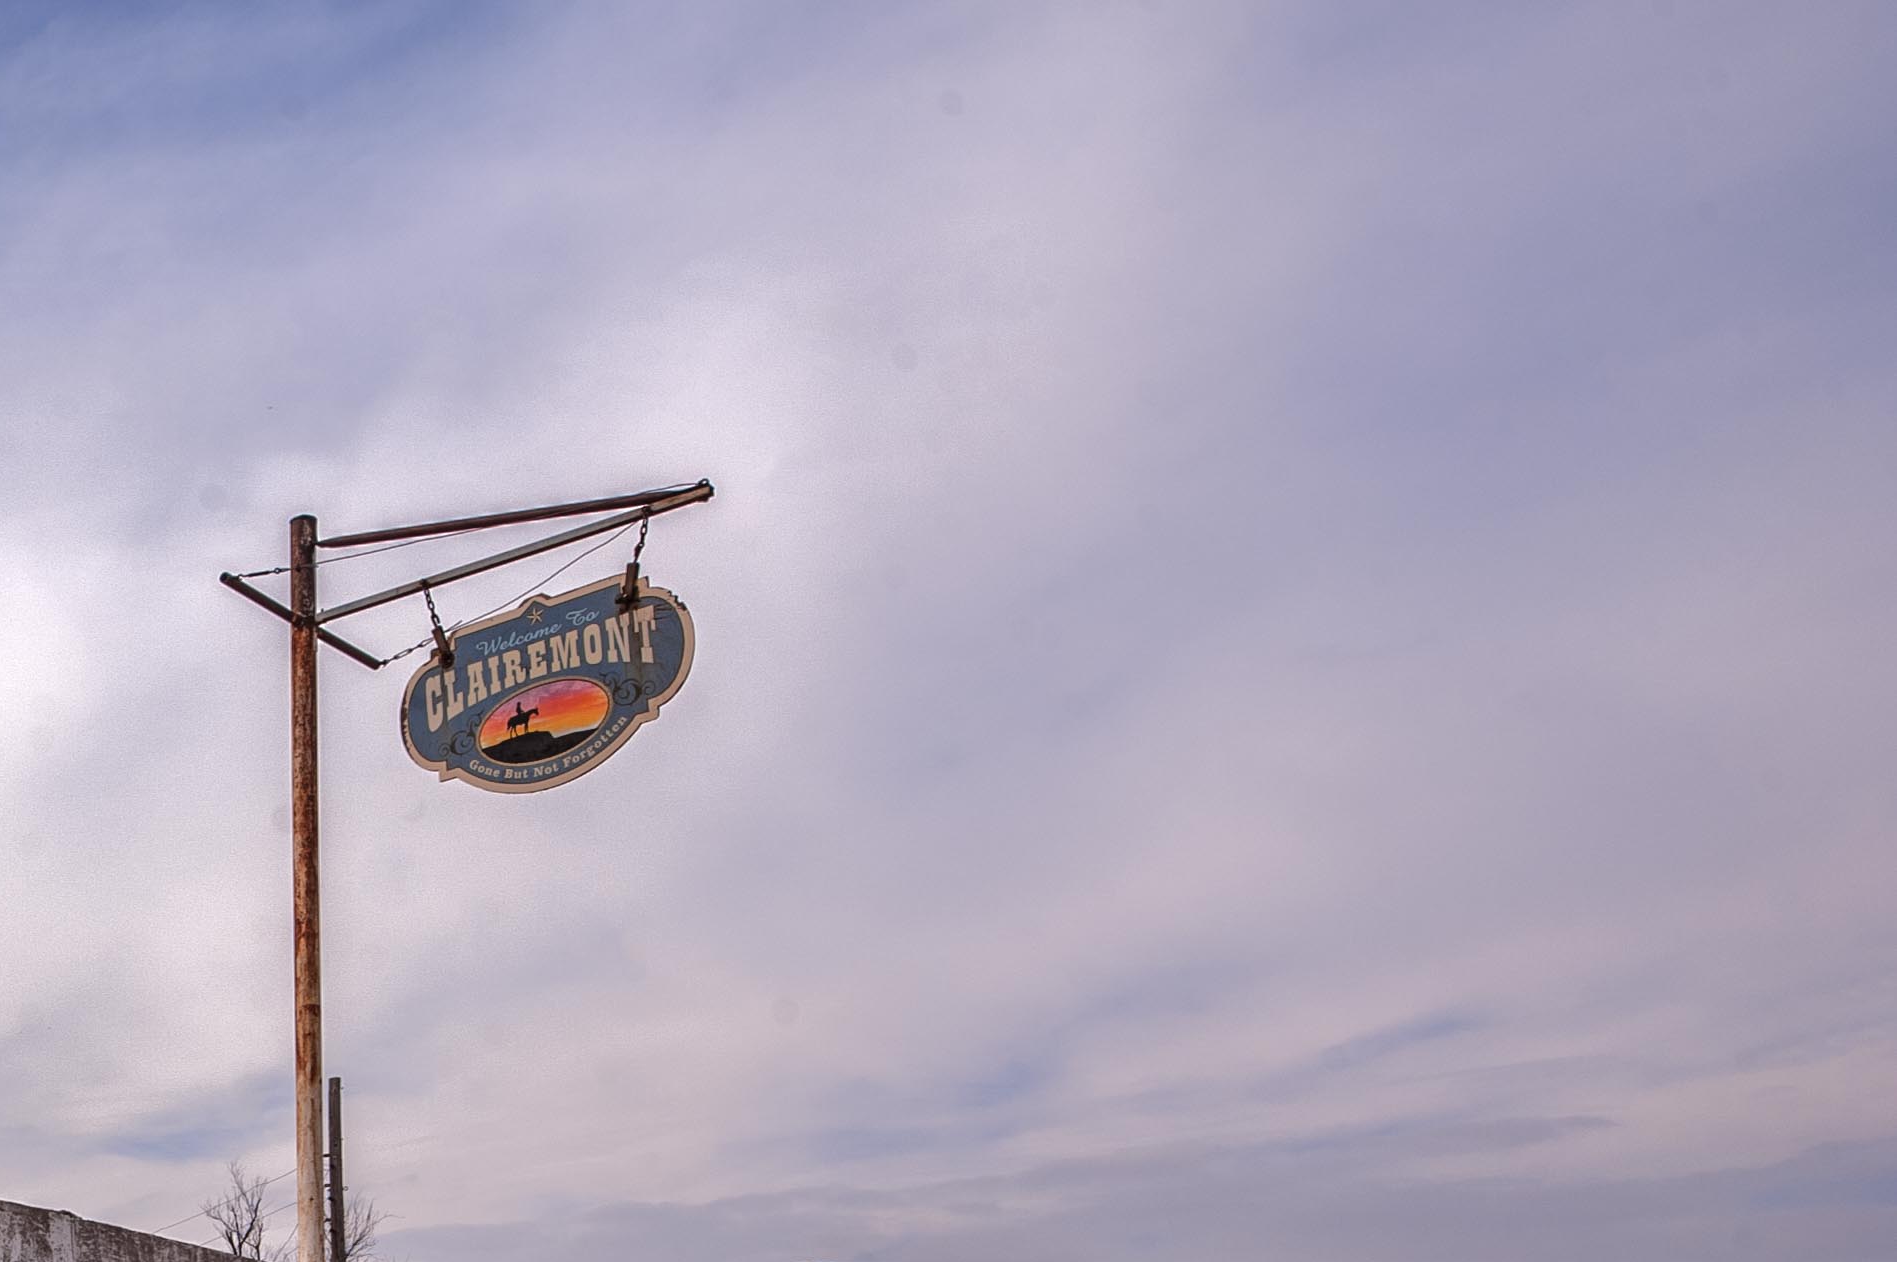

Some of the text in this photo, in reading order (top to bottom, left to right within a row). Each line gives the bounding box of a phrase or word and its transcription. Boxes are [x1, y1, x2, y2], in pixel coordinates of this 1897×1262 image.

[476, 607, 600, 656] Welcome To
[425, 604, 657, 732] CLAIREMONT
[469, 716, 628, 779] Gone But Not Forgotten
